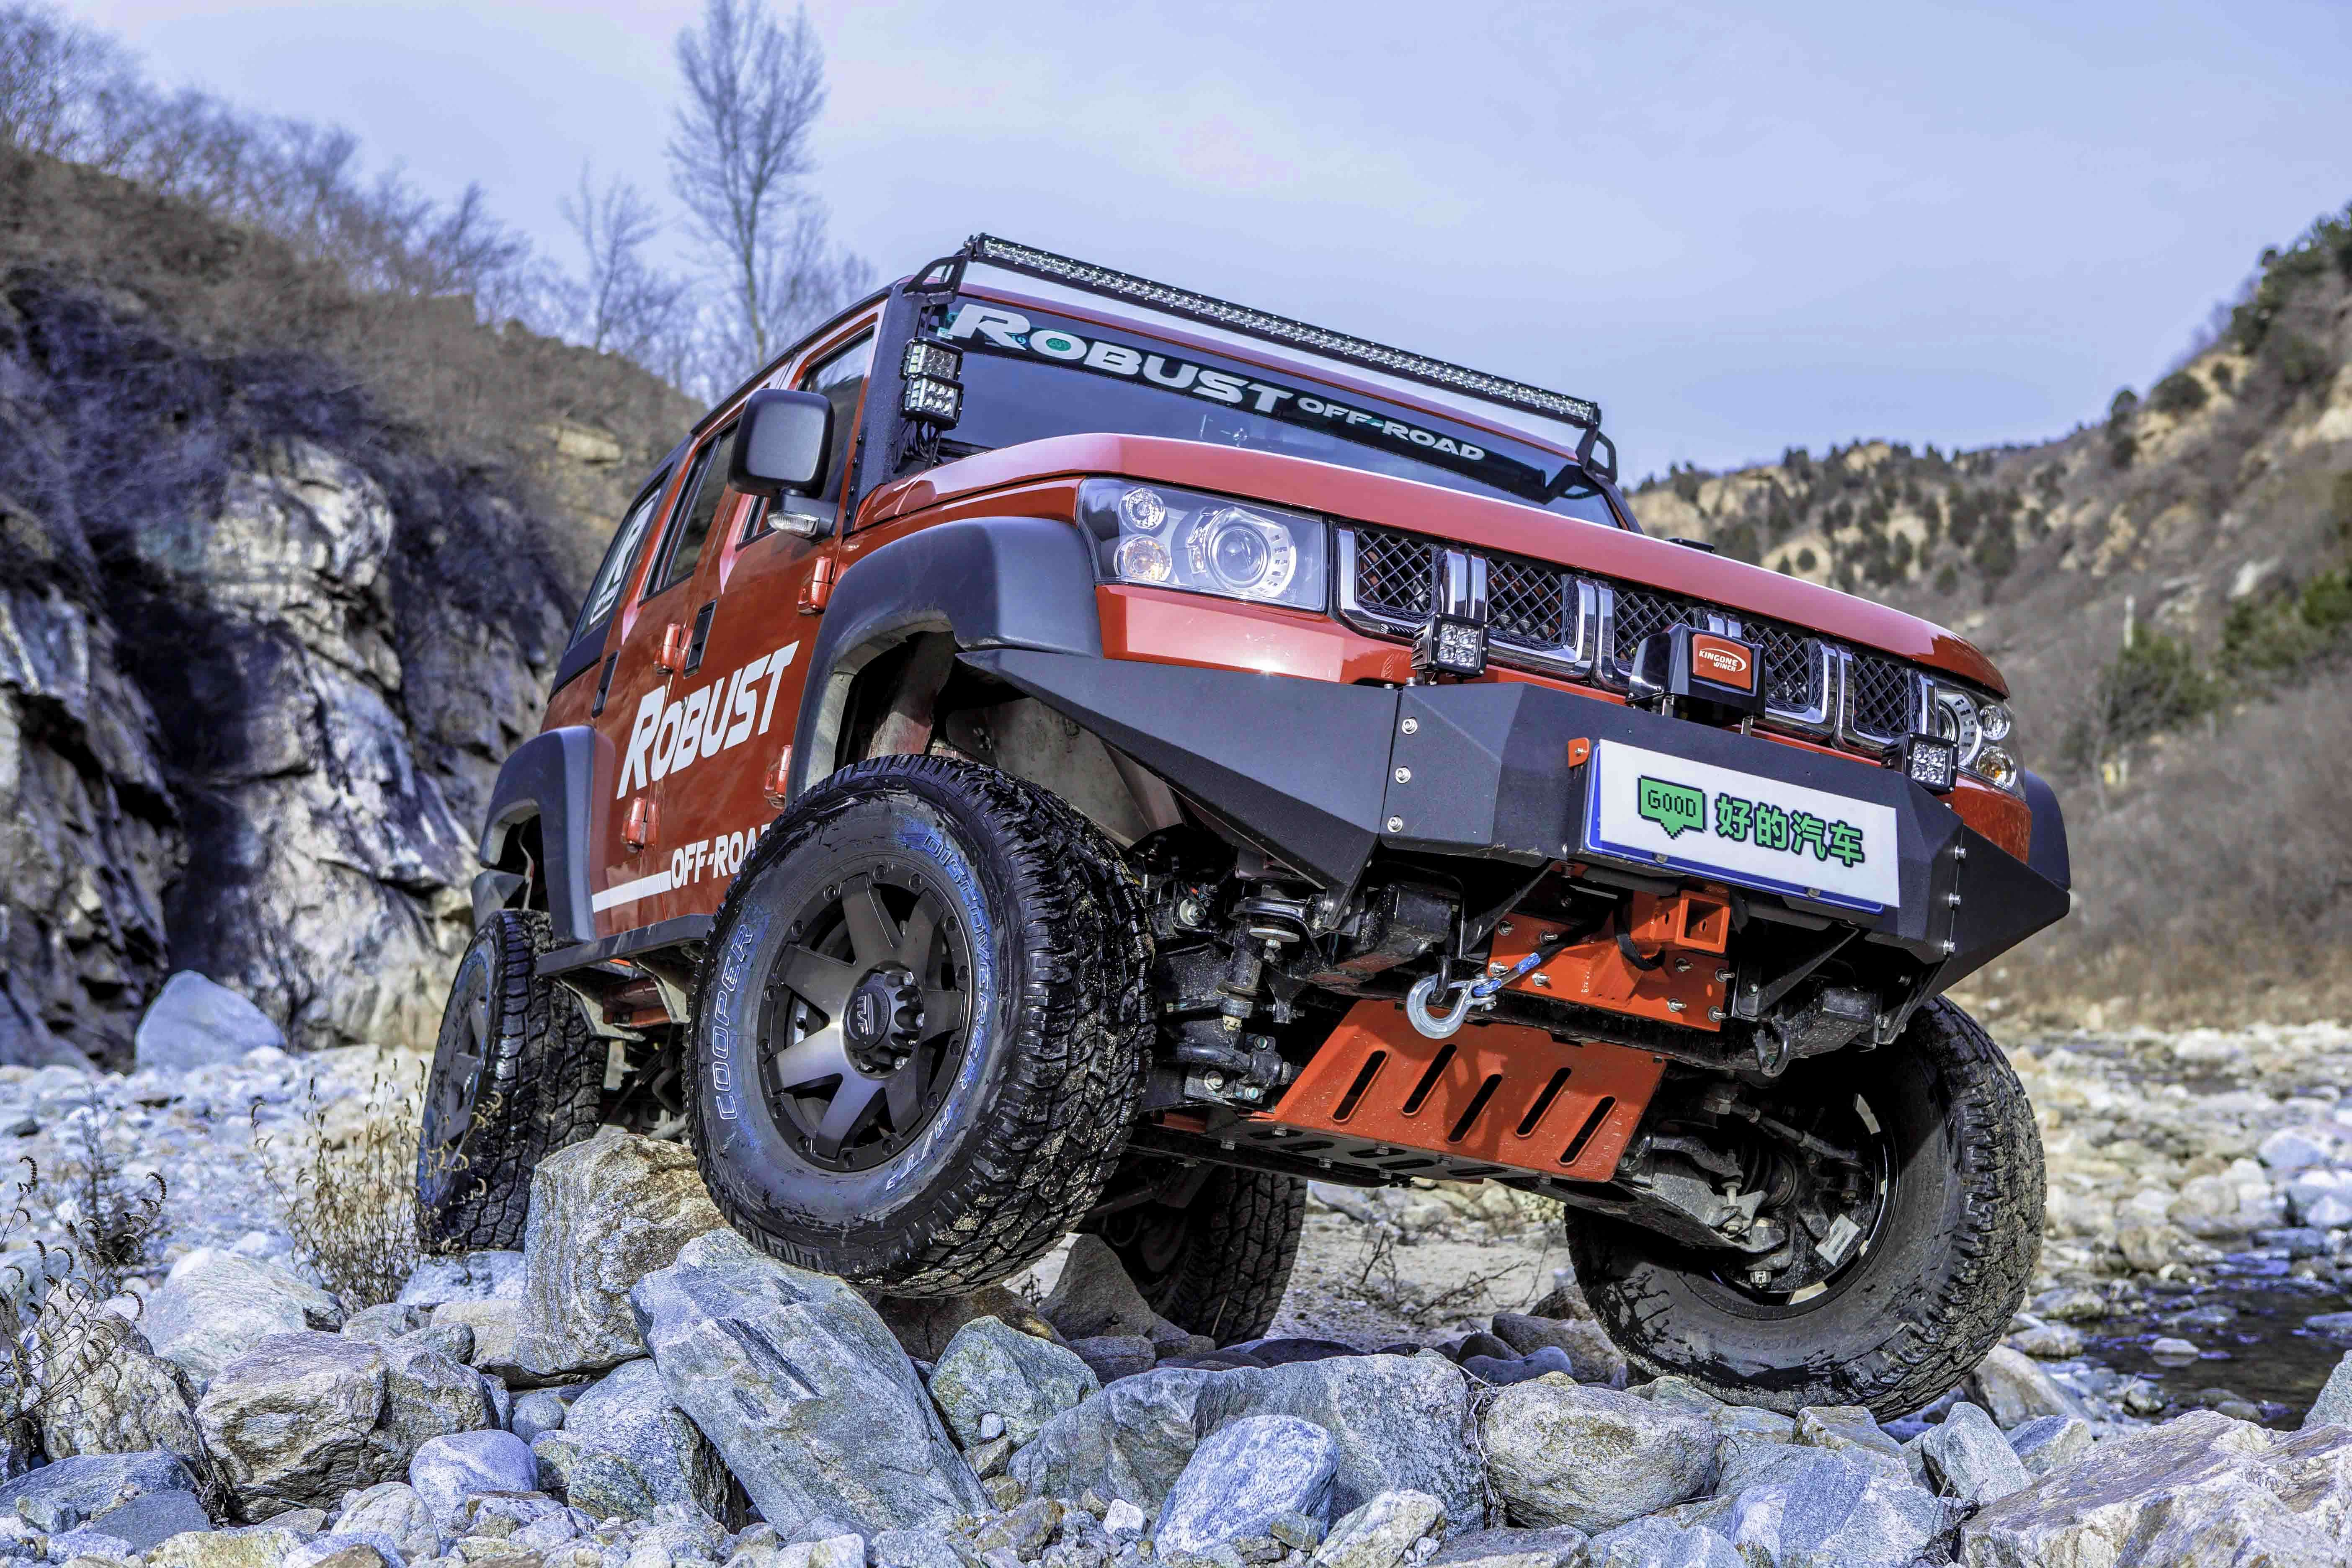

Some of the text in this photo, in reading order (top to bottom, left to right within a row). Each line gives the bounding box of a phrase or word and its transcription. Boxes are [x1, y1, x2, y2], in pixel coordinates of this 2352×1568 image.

[948, 304, 1486, 461] ROBUST OFF-ROAD
[1698, 650, 1739, 667] KINGONE
[1713, 661, 1736, 672] WINCH
[616, 640, 799, 799] ROBUST
[1648, 789, 1696, 818] GOOD
[1715, 792, 1865, 867] 好的汽车
[671, 823, 771, 889] OFF-ROA
[923, 833, 993, 1090] DISCOVERER
[712, 923, 754, 1120] COOPER
